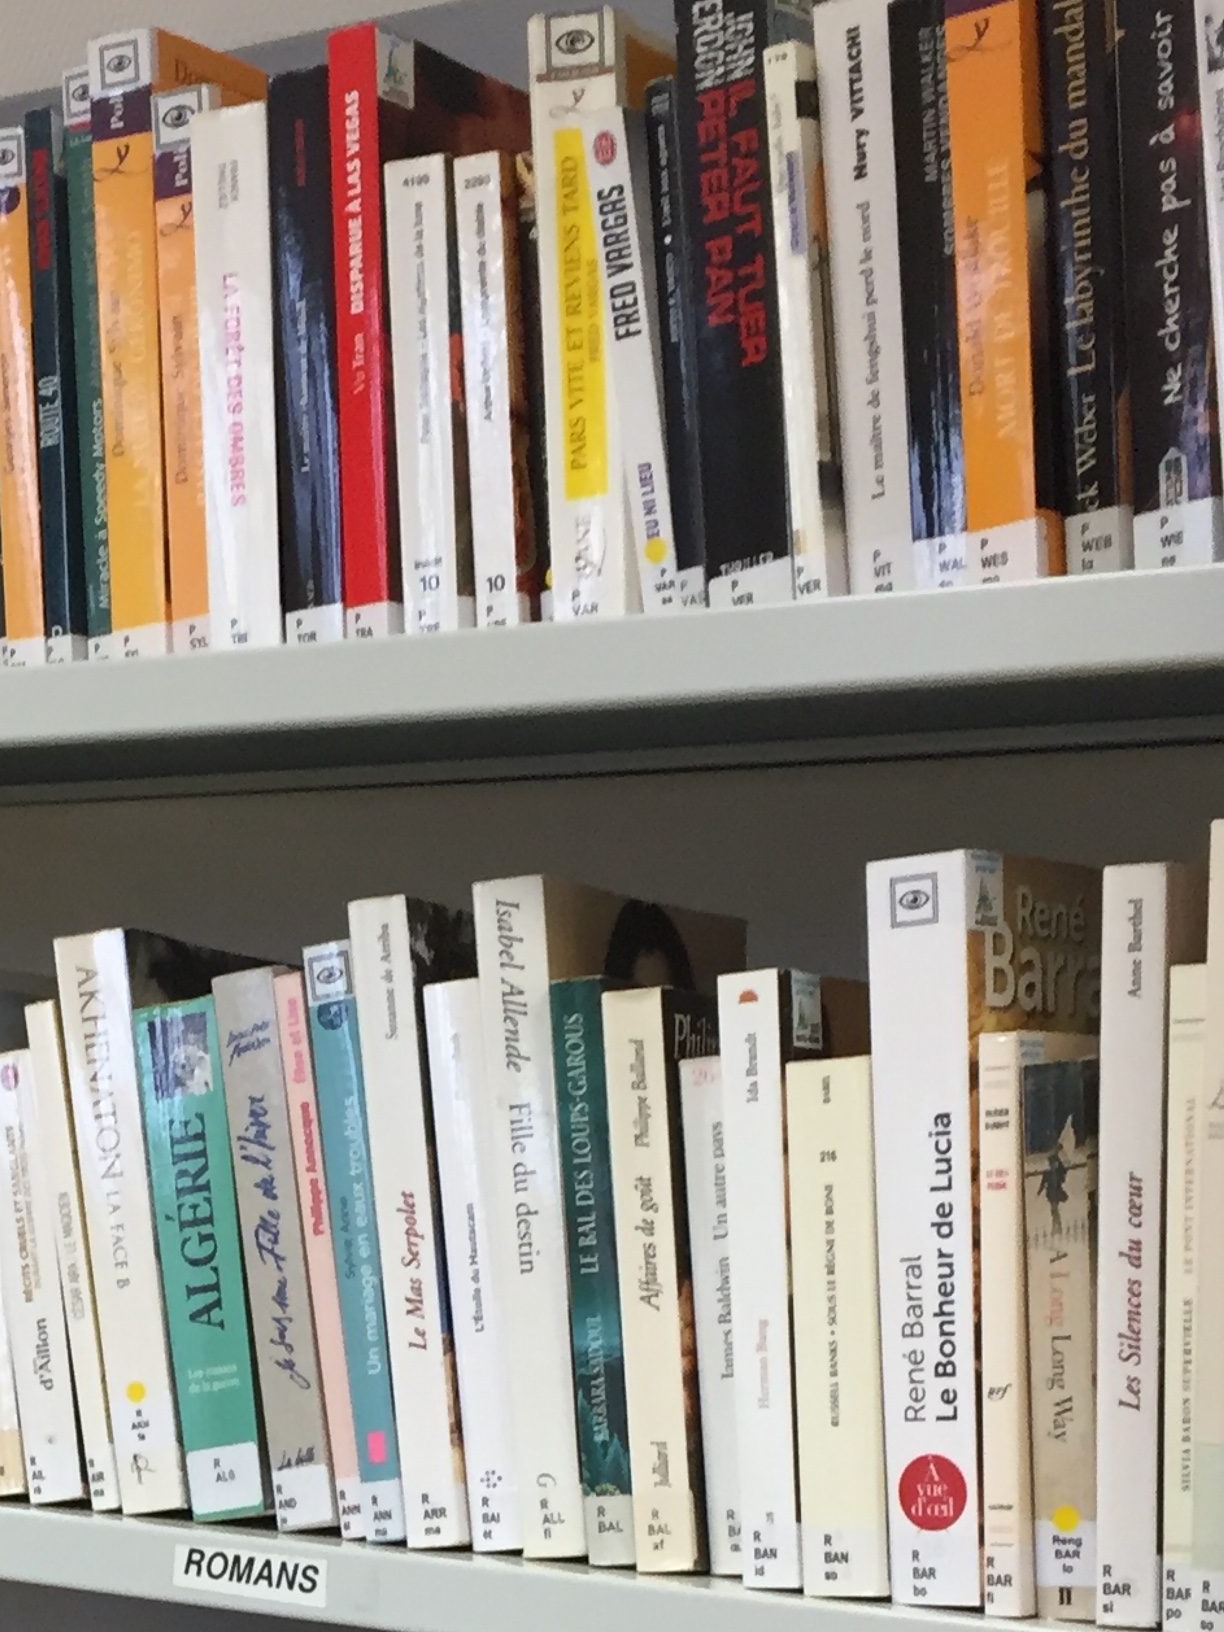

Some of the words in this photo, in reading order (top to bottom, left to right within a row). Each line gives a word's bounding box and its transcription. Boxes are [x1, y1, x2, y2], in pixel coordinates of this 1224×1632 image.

[845, 25, 866, 122] VITTACHI
[1150, 10, 1175, 110] savoir
[344, 90, 361, 157] VEGAS
[1063, 118, 1090, 160] du
[1149, 123, 1176, 145] à
[345, 158, 362, 194] LAS
[696, 87, 731, 225] PETER
[852, 128, 870, 180] Nury
[560, 156, 579, 216] TARD
[1156, 157, 1192, 210] pas
[597, 184, 632, 274] VARGAS
[1060, 169, 1105, 328] labyrinthe
[347, 216, 364, 315] DISPARUE
[562, 223, 582, 318] REVIENS
[704, 234, 735, 328] PAN
[1155, 226, 1180, 351] cherche
[611, 280, 642, 340] FRED
[565, 325, 583, 353] ET
[1067, 336, 1097, 375] Le
[38, 375, 57, 401] 40
[567, 360, 584, 410] VITE
[1162, 362, 1184, 407] Ne
[39, 404, 59, 447] ROUTE
[568, 419, 587, 470] PARS
[1075, 393, 1098, 475] Weber
[495, 898, 523, 970] Isabel
[499, 974, 527, 1073] Allende
[75, 965, 122, 1179] AKHENATON
[563, 1012, 592, 1165] LOUPS-GAROUS
[342, 1095, 365, 1175] troubles
[507, 1103, 531, 1153] Fille
[928, 1111, 953, 1193] Lucia
[351, 1182, 367, 1227] eaux
[512, 1161, 535, 1193] du
[574, 1170, 595, 1206] DES
[1120, 1171, 1145, 1230] cœur
[164, 1112, 225, 1332] ALGÉRIE
[356, 1232, 370, 1259] en
[397, 1190, 427, 1270] Serpolet
[512, 1200, 536, 1275] destin
[576, 1210, 597, 1247] BAL
[931, 1200, 955, 1240] de
[578, 1252, 600, 1274] LE
[1119, 1236, 1144, 1269] du
[360, 1265, 383, 1342] mariage
[403, 1278, 423, 1318] Mas
[899, 1255, 925, 1339] Barral
[931, 1247, 956, 1378] Bonheur
[1117, 1279, 1146, 1368] Silences
[31, 1317, 55, 1391] d'Aillon
[366, 1347, 381, 1375] Un
[406, 1324, 428, 1351] Le
[902, 1347, 926, 1424] René
[934, 1385, 958, 1422] Le
[1118, 1376, 1143, 1412] Les
[184, 1548, 319, 1593] ROMANS
[913, 1567, 936, 1580] BAR
[1103, 1583, 1131, 1596] BAR
